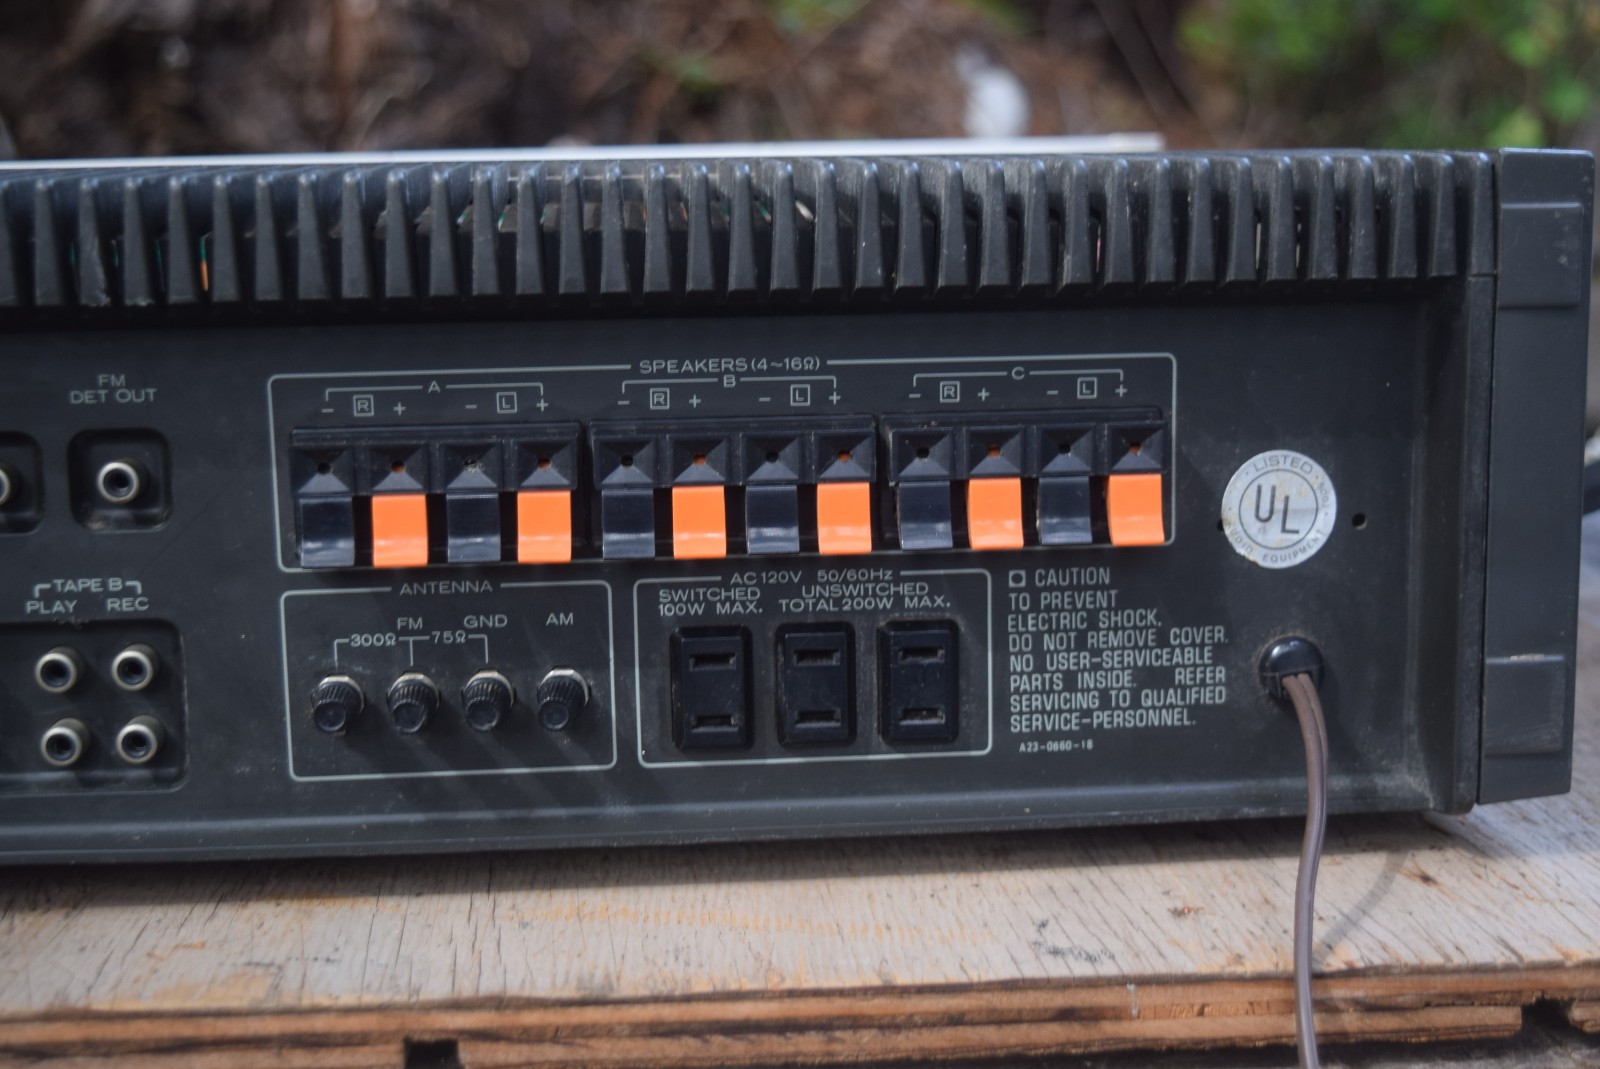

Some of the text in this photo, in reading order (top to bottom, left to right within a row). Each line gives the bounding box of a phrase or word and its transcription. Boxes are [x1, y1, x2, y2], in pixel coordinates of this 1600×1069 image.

[99, 374, 125, 387] FM
[723, 374, 737, 388] B
[1011, 366, 1025, 380] C
[428, 380, 441, 393] A
[70, 388, 157, 404] DET OUT
[1252, 454, 1314, 475] LISTED
[1254, 484, 1300, 535] UL
[53, 577, 122, 593] TAPE B
[730, 569, 893, 586] AC 120V 50/60Hz
[1034, 567, 1111, 587] CAUTION
[400, 580, 493, 596] ANTENNA
[659, 587, 761, 602] SWITCHED
[802, 583, 929, 599] UNSWITCHED
[26, 597, 149, 614] PLAY REC
[778, 594, 951, 613] TOTAL 200W MAX.
[1008, 589, 1118, 611] TO PREVENT
[658, 601, 763, 617] 100W MAX.
[397, 617, 423, 630] FM
[463, 614, 508, 629] GND
[546, 612, 574, 626] AM
[1007, 611, 1087, 633] ELECTRIC
[1009, 625, 1229, 652] DO NOT REMOVE COVER.
[1010, 646, 1213, 673] NO USER-SERVICEABLE
[1010, 665, 1226, 693] PARTS INSIDE. REFER
[1010, 686, 1227, 713] SERVICING TO QUALIFIED
[1010, 707, 1196, 733] SERVICE-PERSONNEL.
